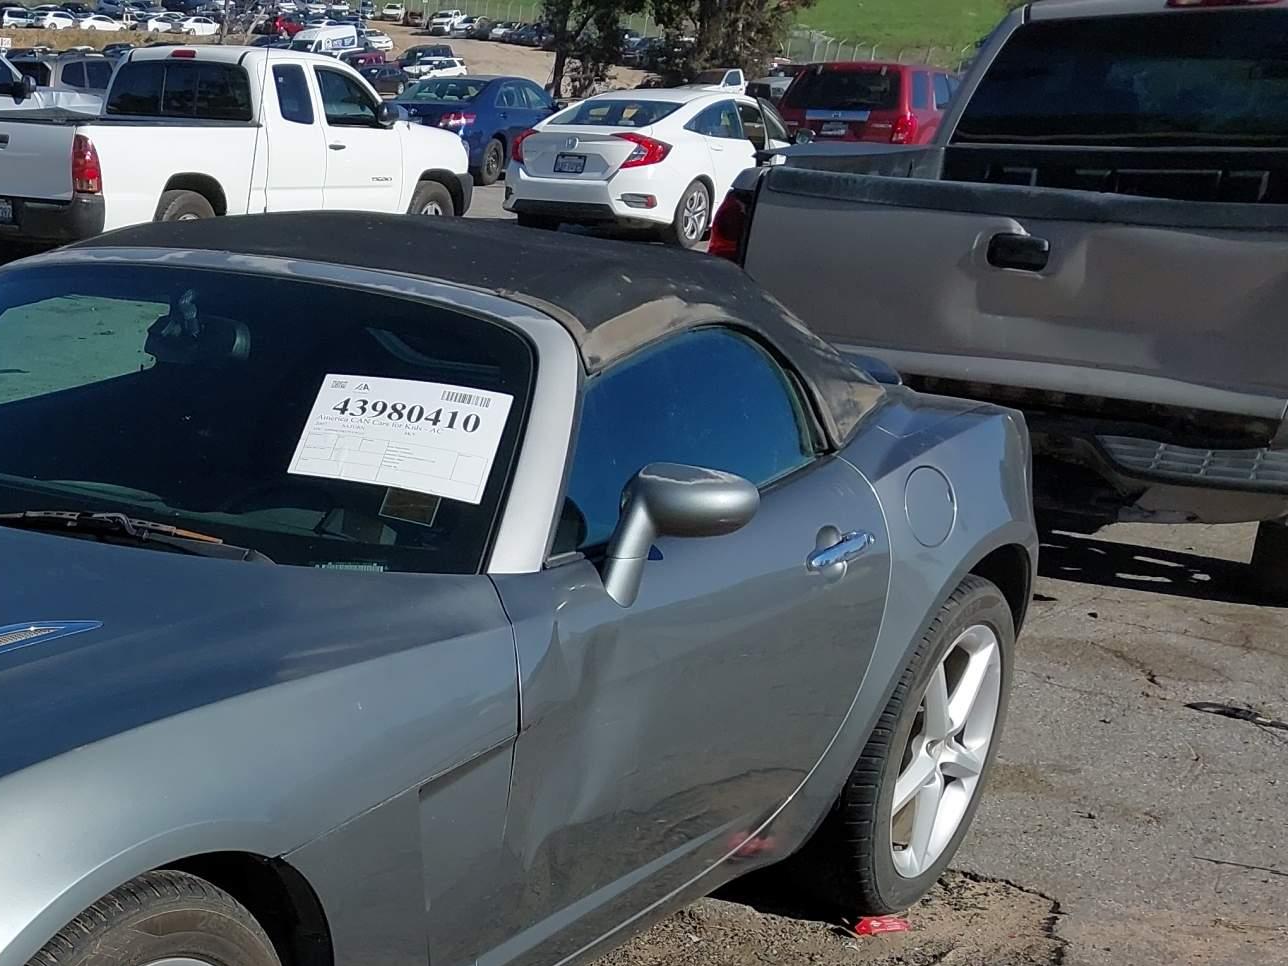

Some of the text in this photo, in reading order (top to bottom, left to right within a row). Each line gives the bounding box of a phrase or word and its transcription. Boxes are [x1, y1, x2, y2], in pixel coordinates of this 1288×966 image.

[317, 414, 349, 423] America
[351, 417, 371, 425] CAN
[332, 397, 481, 433] 43980410
